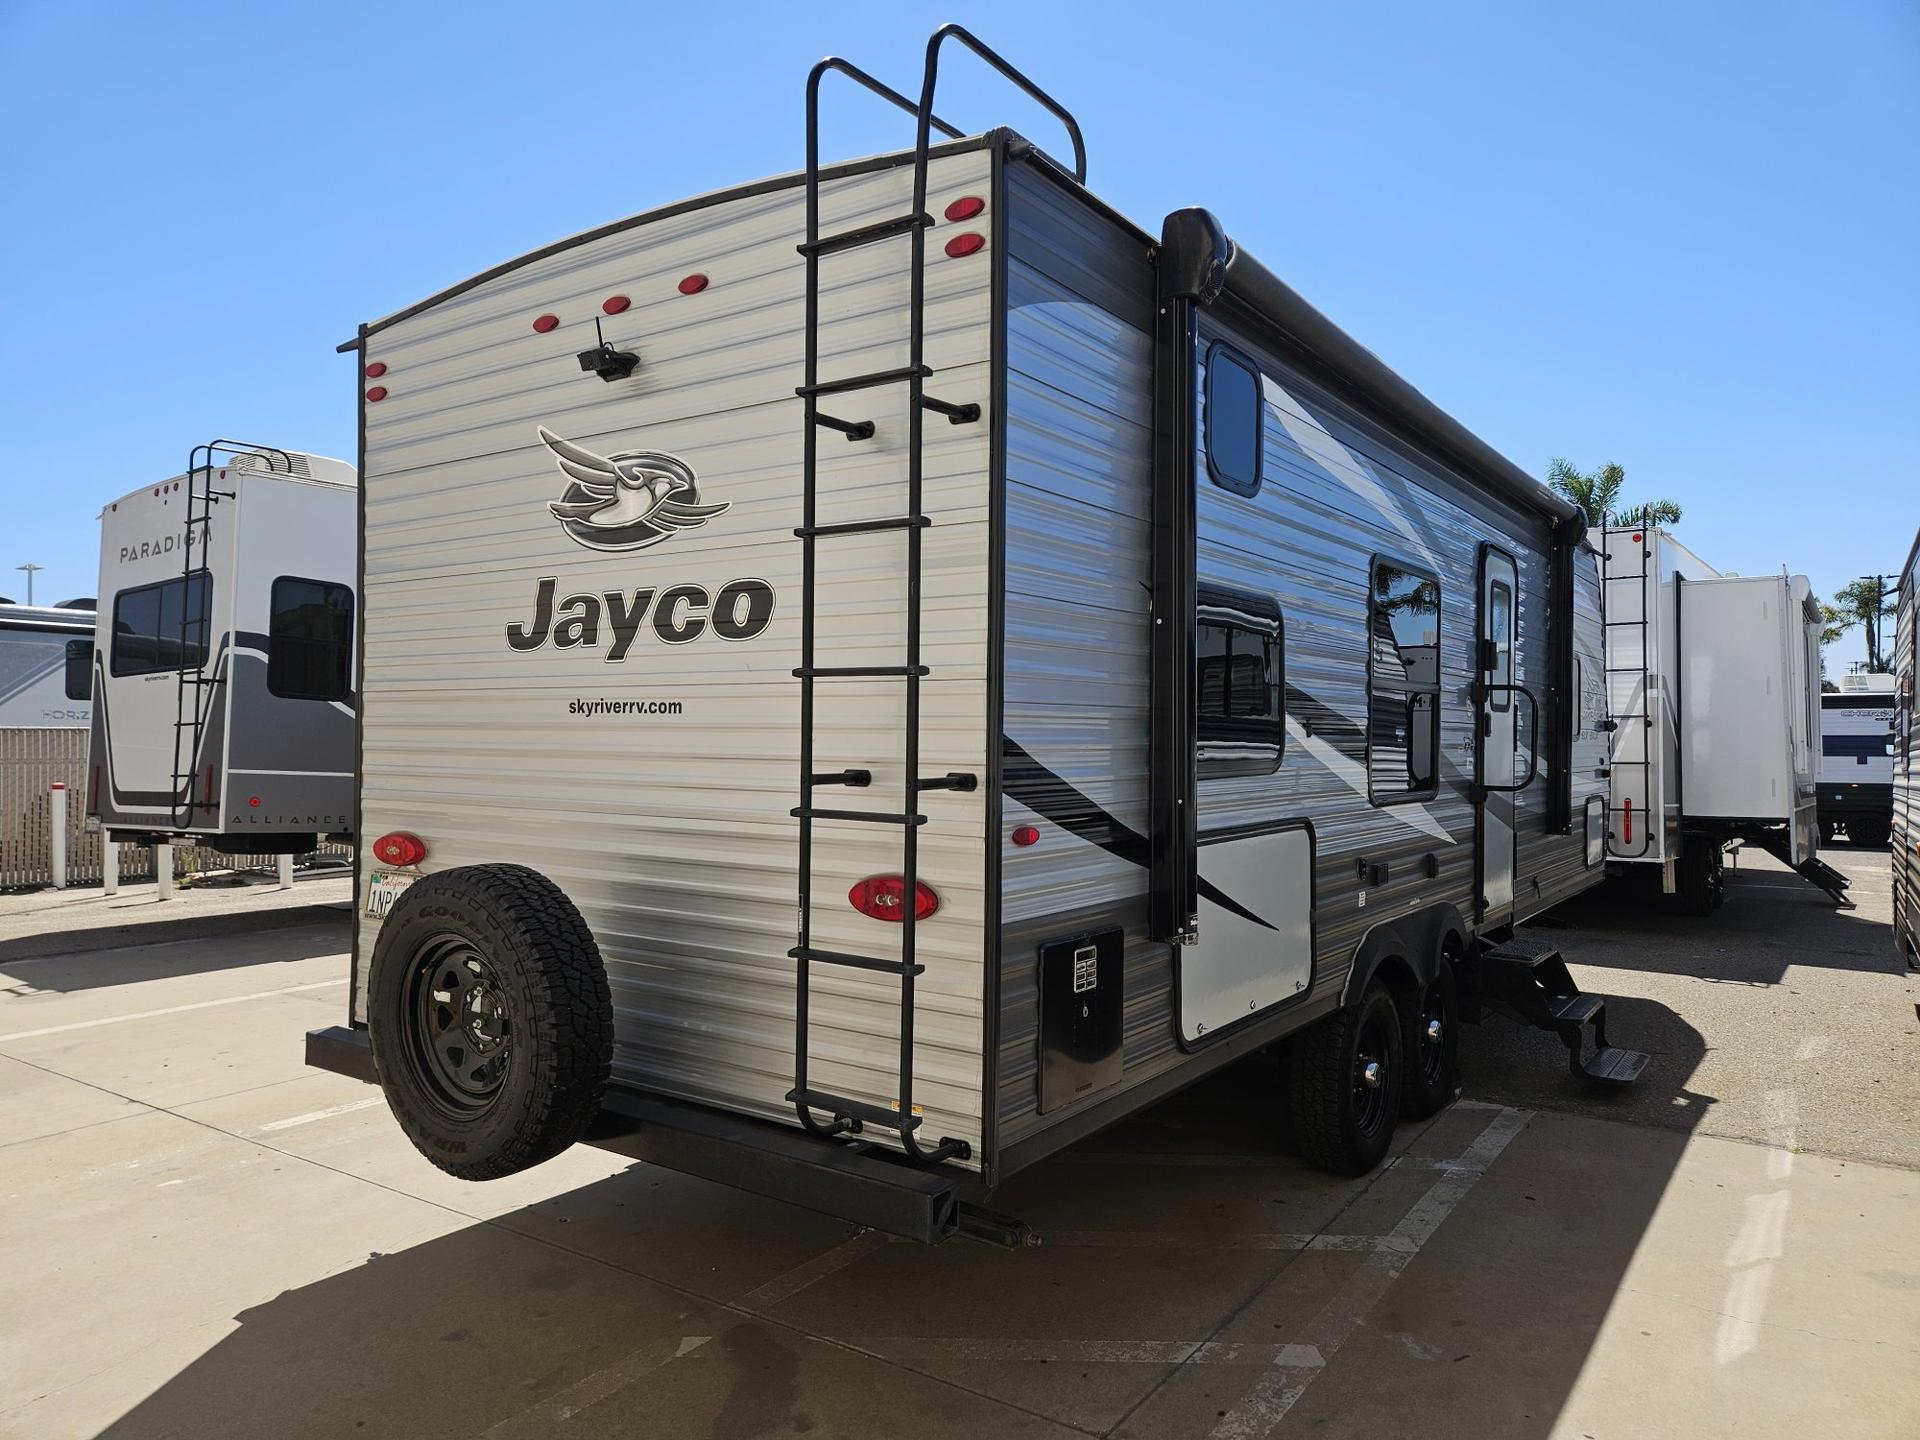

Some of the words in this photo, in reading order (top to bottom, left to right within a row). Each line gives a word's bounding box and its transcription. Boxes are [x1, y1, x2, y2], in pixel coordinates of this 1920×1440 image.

[119, 525, 212, 564] PARADIGM
[506, 576, 776, 663] Jayco
[568, 697, 683, 718] skyriverrv.com
[231, 815, 347, 825] ALLIANCE
[368, 890, 398, 914] 1NP
